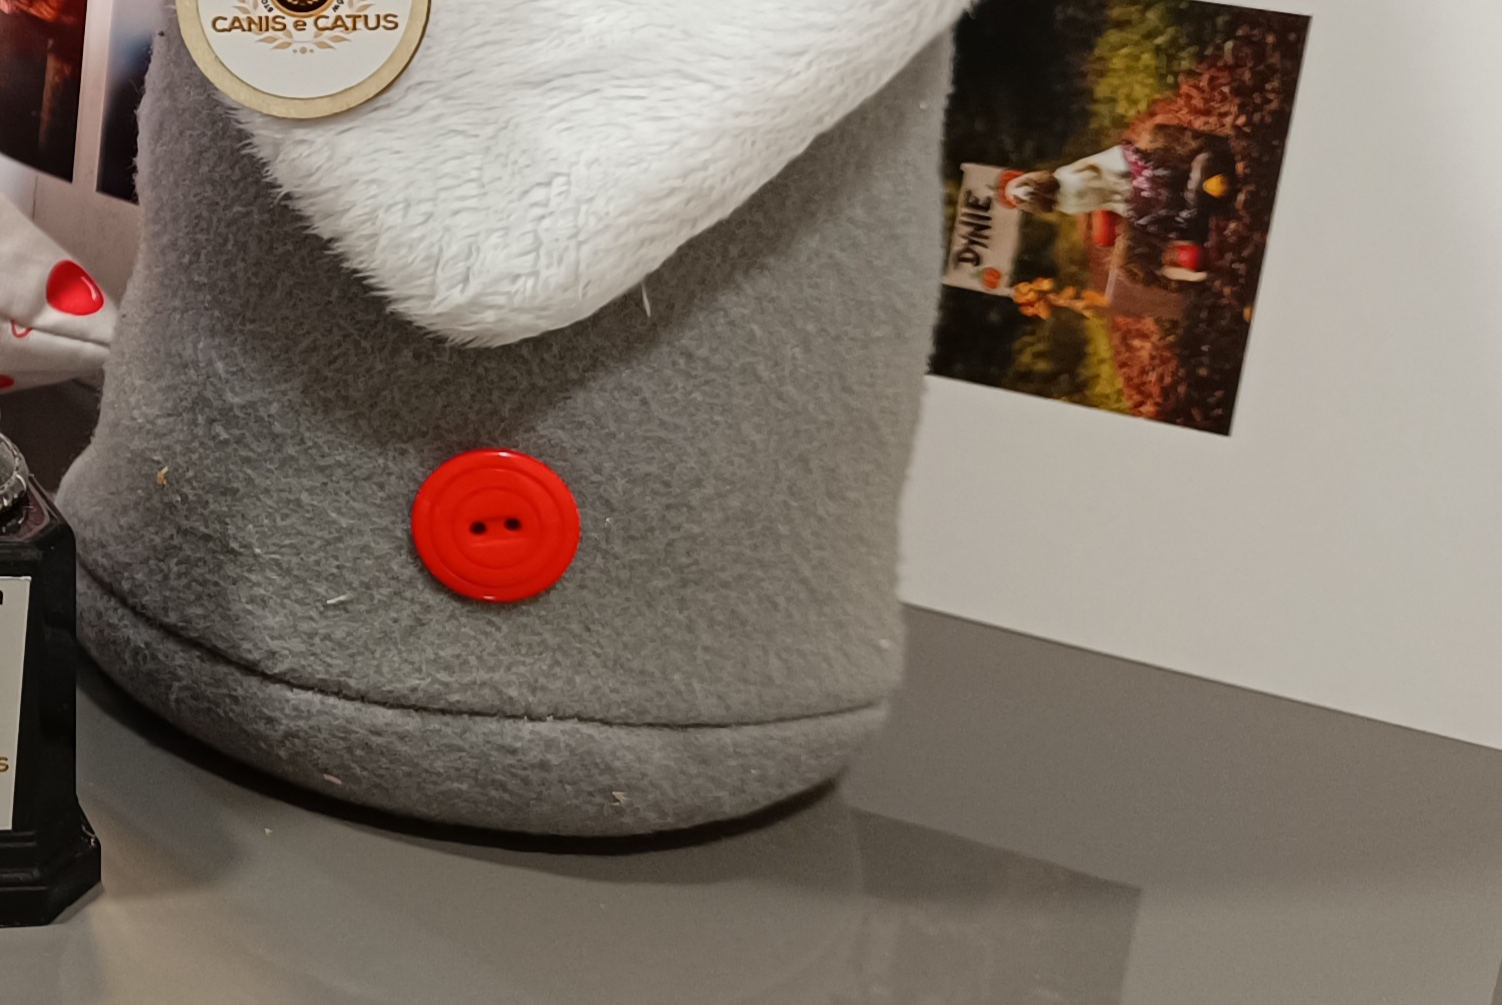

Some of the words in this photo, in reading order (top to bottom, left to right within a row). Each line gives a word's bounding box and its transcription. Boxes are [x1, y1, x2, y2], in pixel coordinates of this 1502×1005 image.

[211, 15, 287, 33] CANIS
[293, 19, 307, 32] e
[314, 14, 399, 31] CATUS
[953, 188, 992, 270] DYNIE
